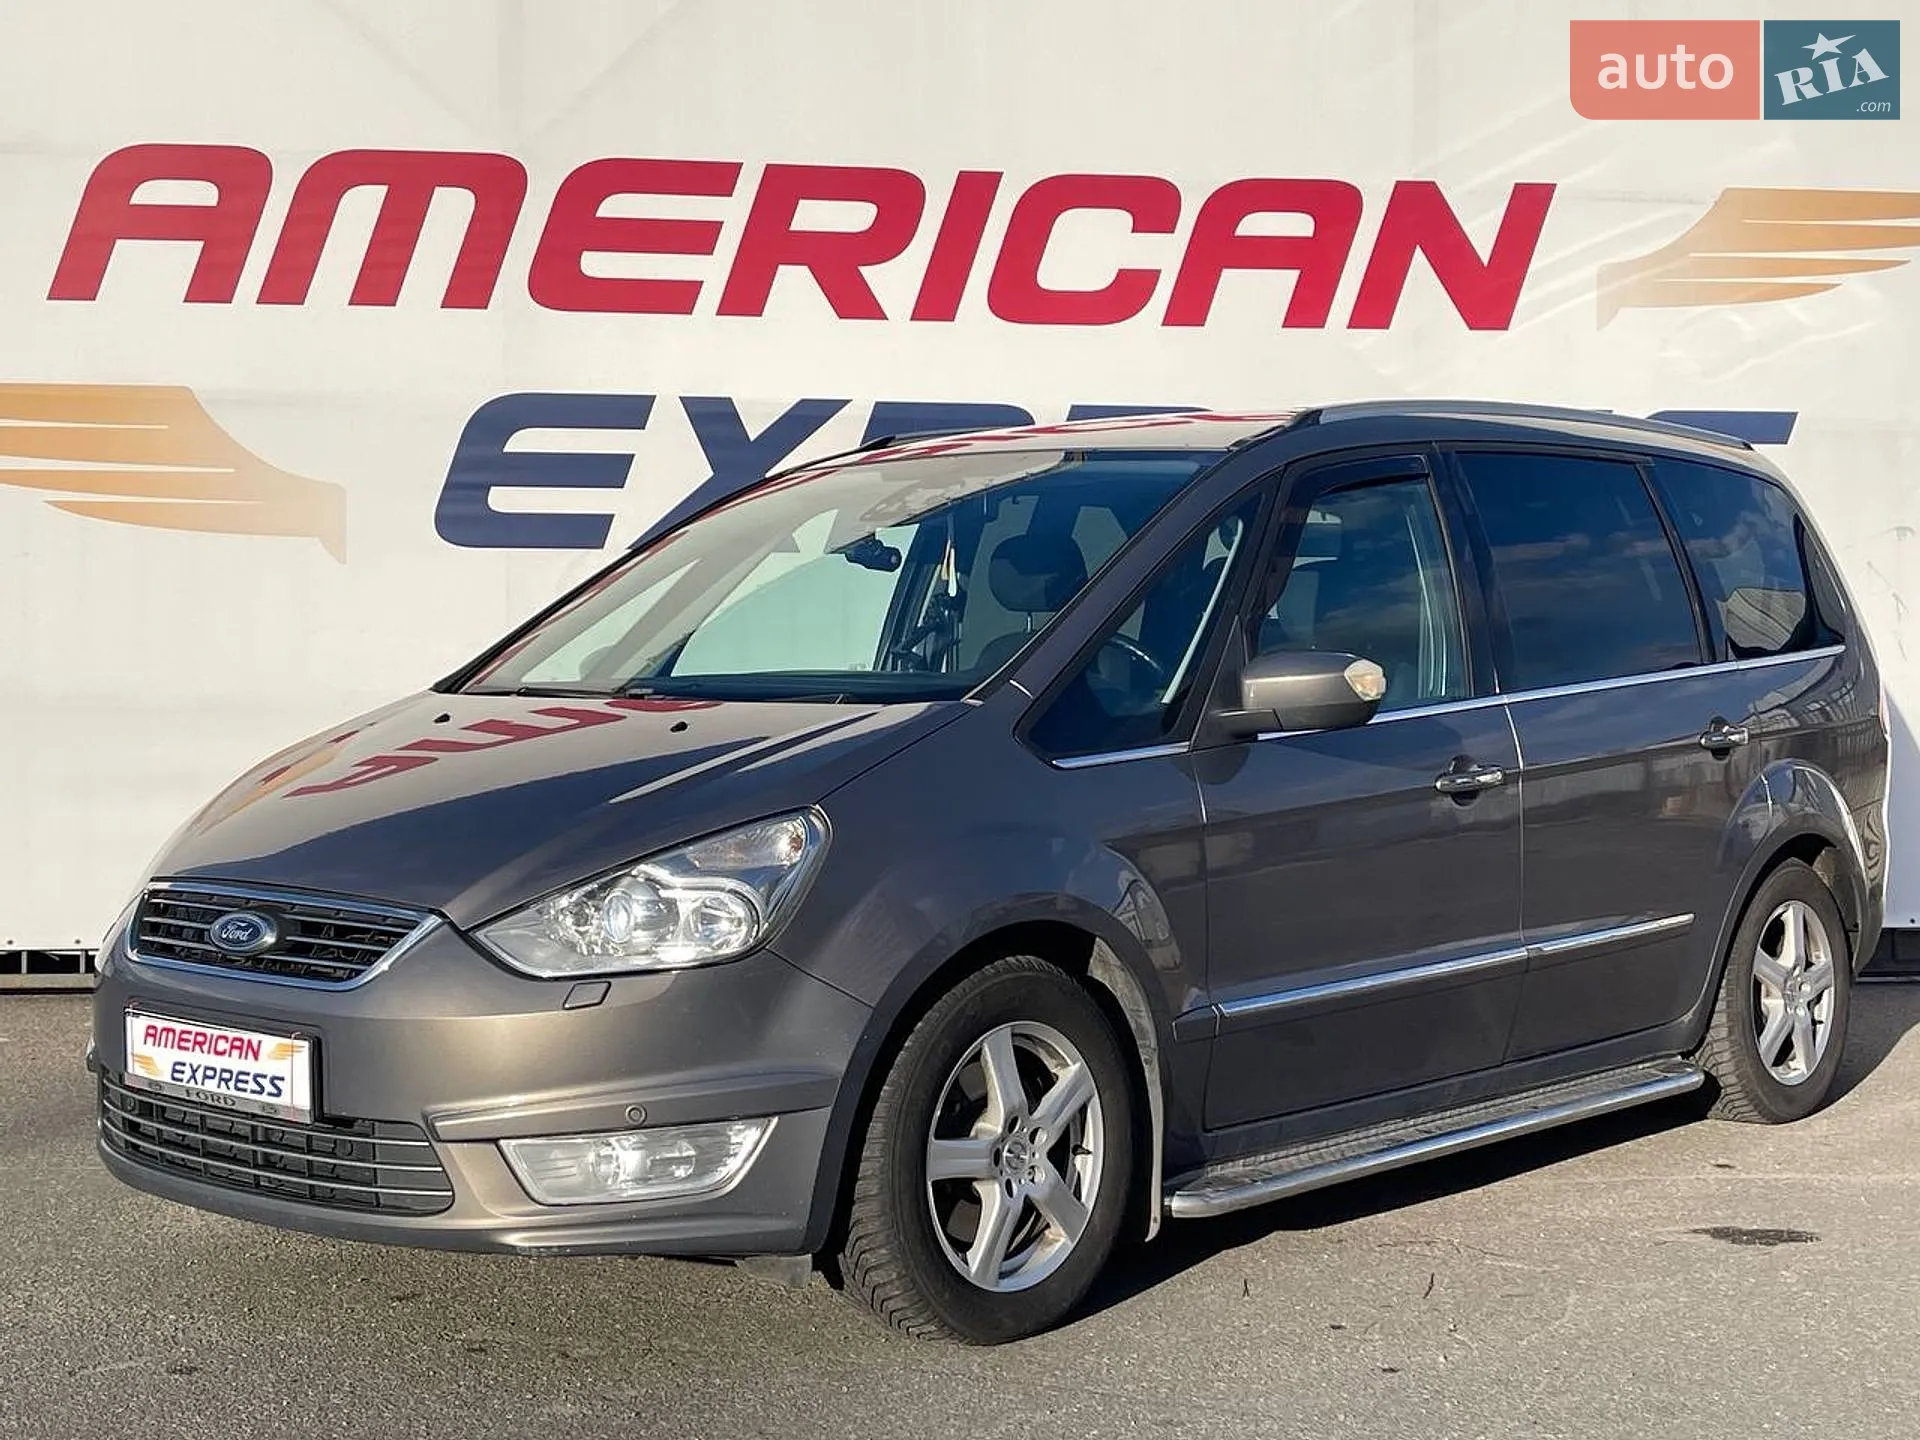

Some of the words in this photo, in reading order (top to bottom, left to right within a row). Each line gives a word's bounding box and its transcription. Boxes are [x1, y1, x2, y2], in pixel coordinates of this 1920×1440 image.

[47, 143, 1556, 331] AMERICAN
[221, 921, 253, 940] Ford
[143, 1024, 263, 1062] AMERICAN
[170, 1061, 285, 1098] EXPRESS
[185, 1089, 236, 1106] FORD
